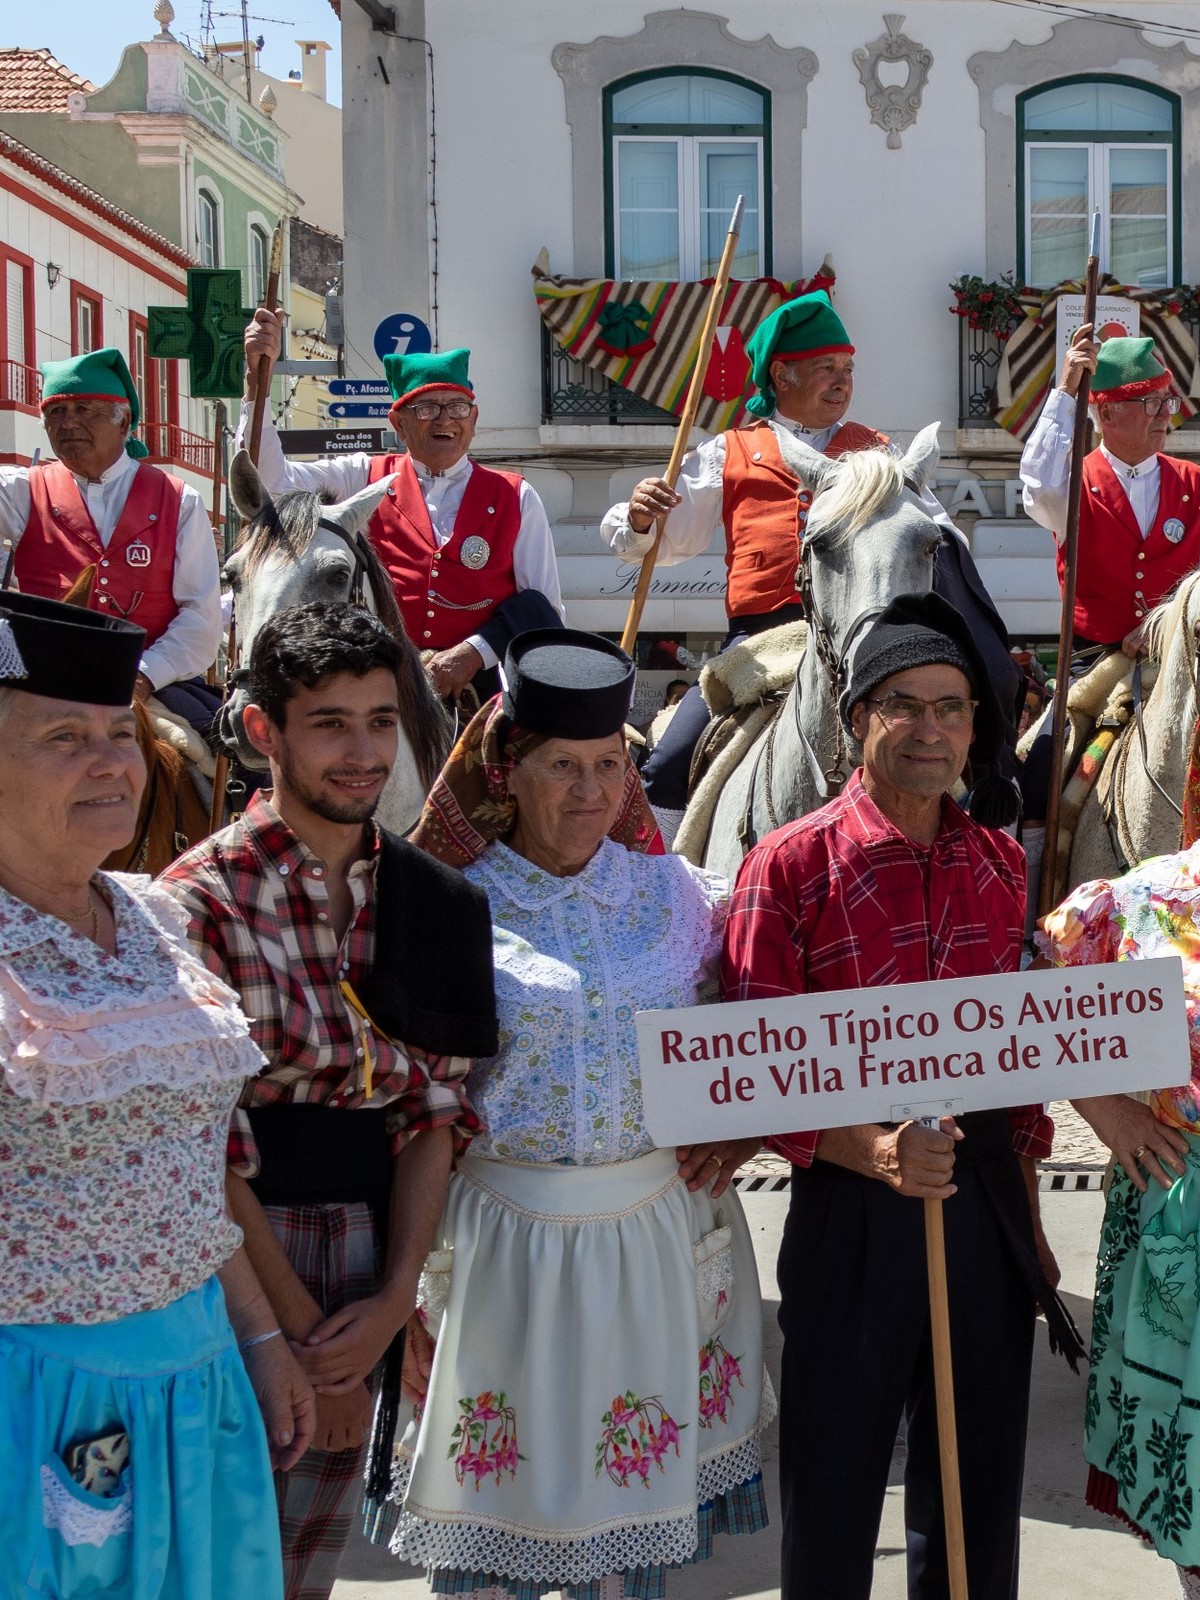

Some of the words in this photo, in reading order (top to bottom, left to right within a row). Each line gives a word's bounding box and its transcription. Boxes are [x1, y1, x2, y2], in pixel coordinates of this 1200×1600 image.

[1096, 305, 1131, 313] NCARNADO
[345, 384, 358, 395] Pç.
[361, 384, 390, 393] Afonso
[368, 405, 379, 415] Rua
[357, 432, 372, 440] dos
[325, 440, 373, 450] Forcados
[634, 689, 663, 698] ÊNCIA
[661, 1017, 808, 1065] Rancho
[820, 1005, 939, 1056] Típico
[953, 998, 1004, 1033] Os
[1017, 982, 1164, 1026] Avieiros
[709, 1066, 755, 1106] de
[768, 1057, 845, 1097] Vila
[858, 1049, 986, 1089] Franca
[997, 1035, 1041, 1073] de
[1054, 1028, 1129, 1066] Xira
